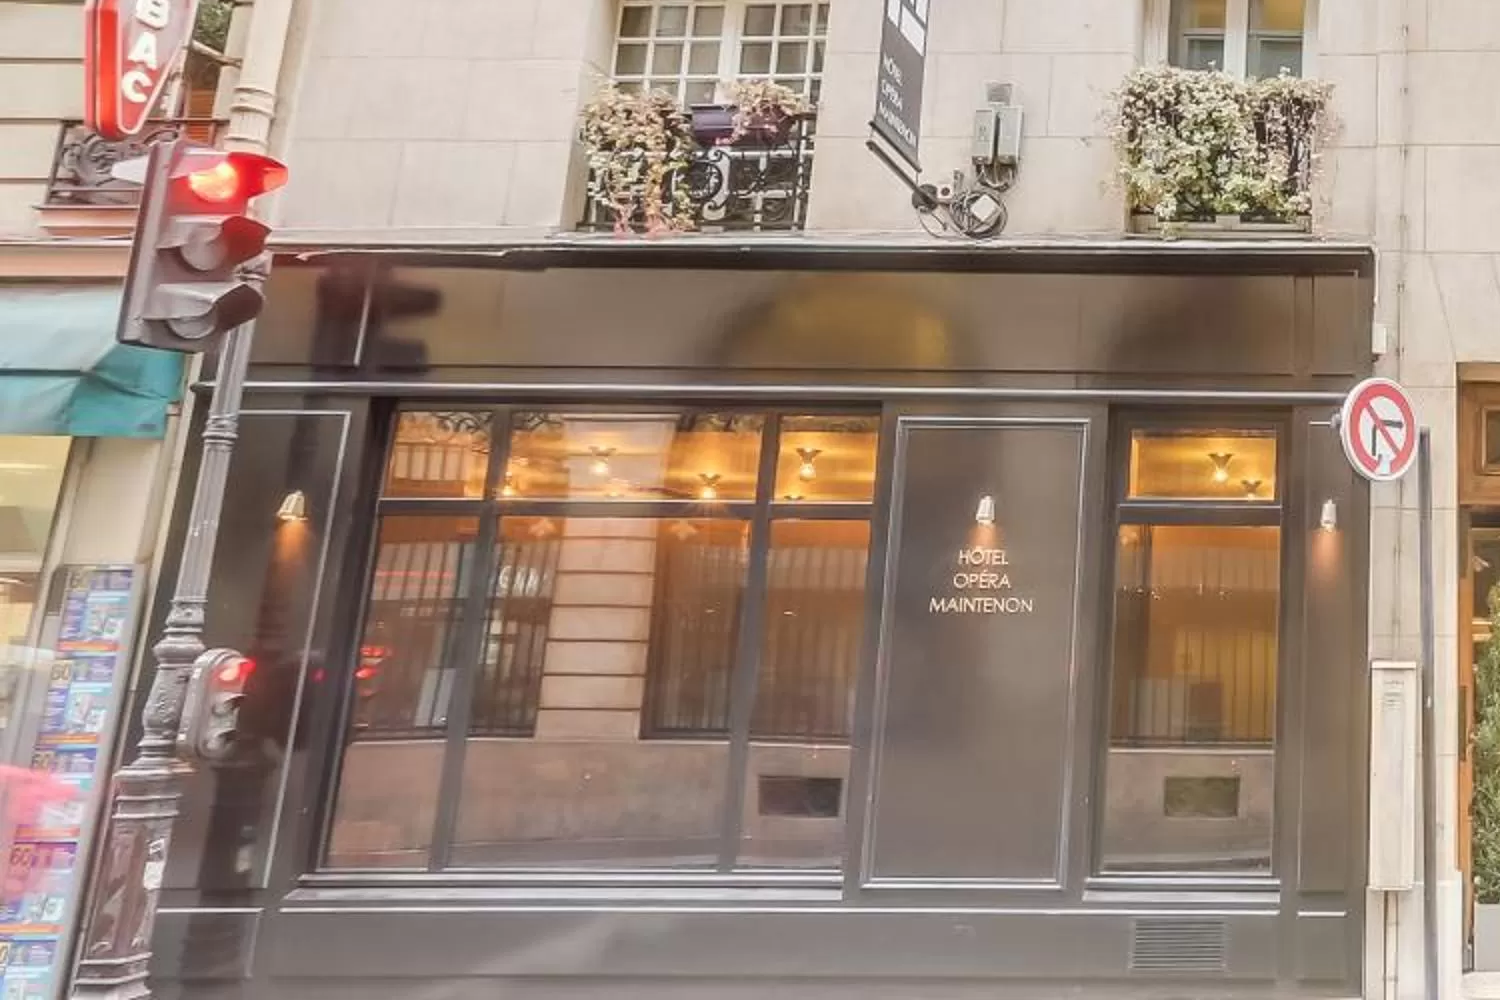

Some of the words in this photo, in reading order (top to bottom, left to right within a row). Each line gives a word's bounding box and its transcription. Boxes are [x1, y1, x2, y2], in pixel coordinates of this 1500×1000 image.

[958, 547, 1009, 566] HÔTEL
[953, 570, 1012, 589] OPÉRA
[929, 597, 1034, 614] MAINTENON
